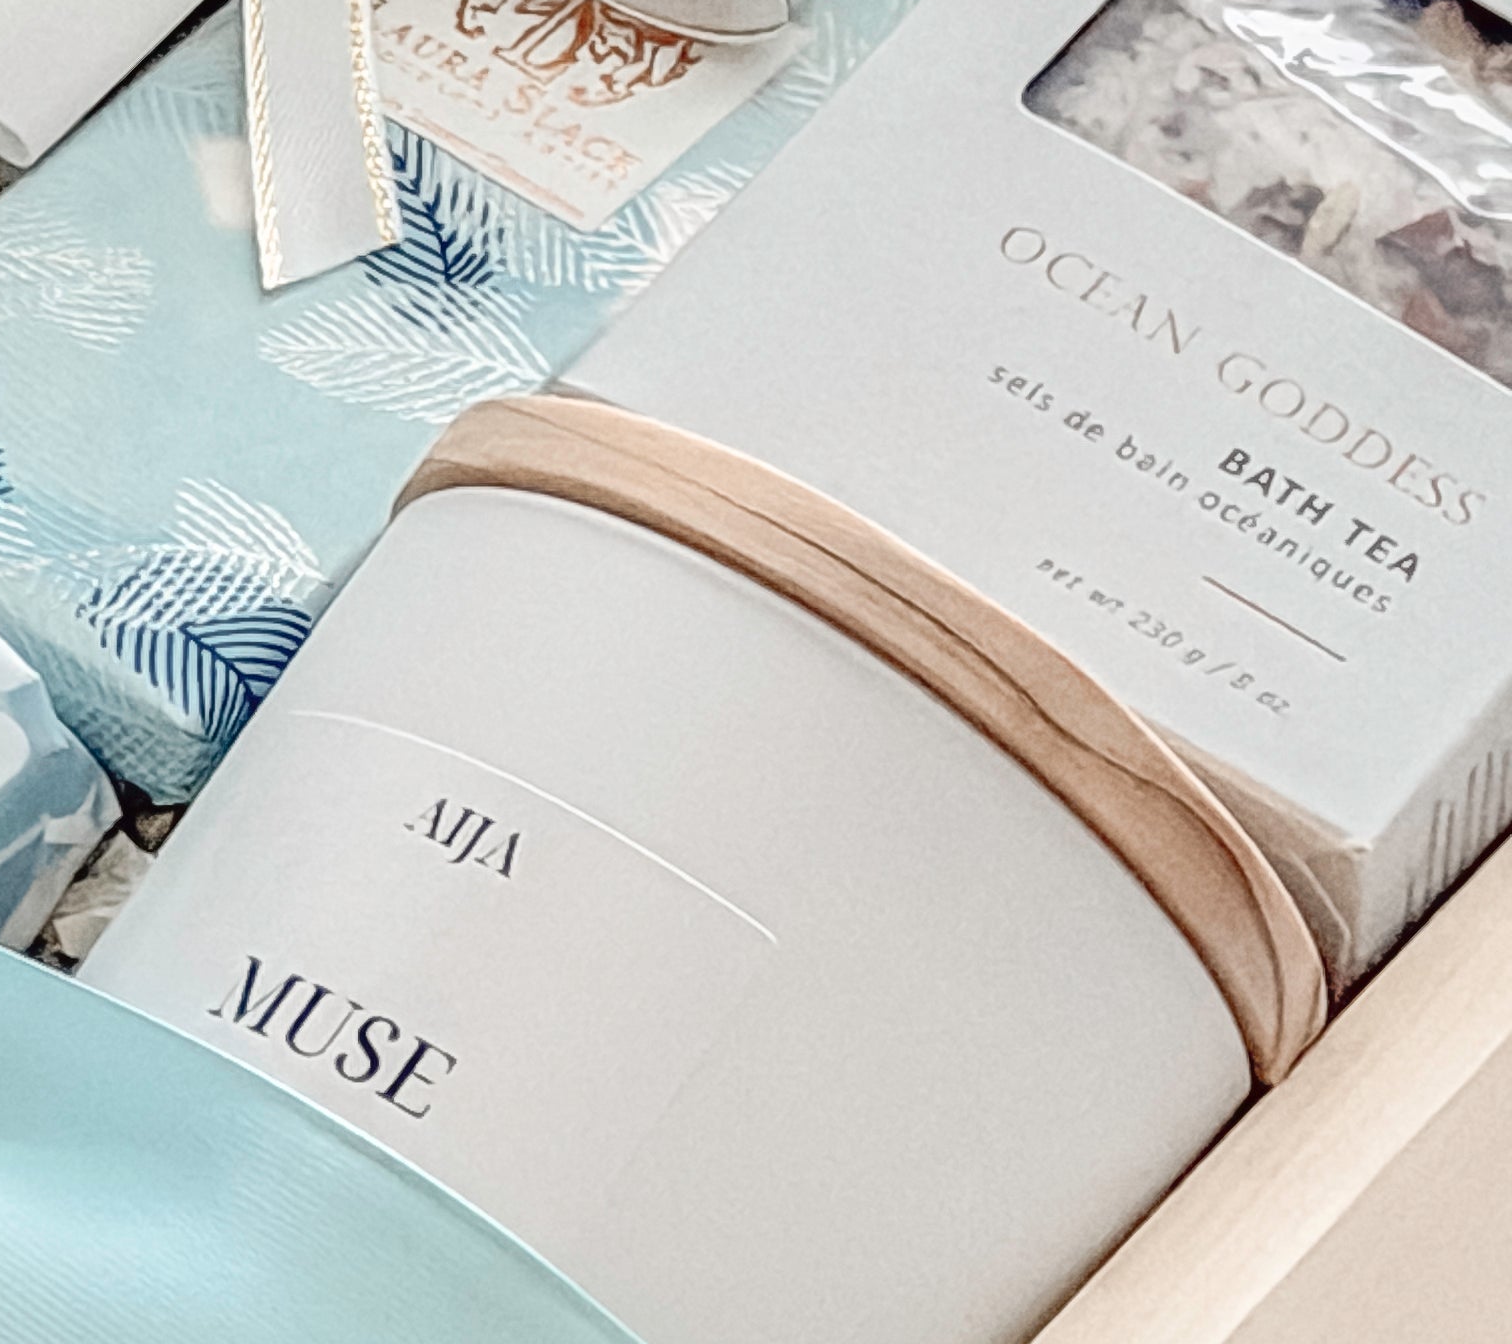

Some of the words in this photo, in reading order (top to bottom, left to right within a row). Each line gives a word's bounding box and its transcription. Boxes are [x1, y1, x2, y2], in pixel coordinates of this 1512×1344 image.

[999, 226, 1201, 354] OCEAN
[1216, 351, 1487, 527] GODDESS
[987, 364, 1055, 413] sels
[1062, 409, 1106, 443] de
[1114, 433, 1189, 493] bain
[1197, 489, 1394, 615] océaniques
[1218, 447, 1334, 526] BATH
[1343, 516, 1421, 583] TEA
[1127, 610, 1185, 649] 230
[402, 797, 522, 879] AIJA
[206, 954, 458, 1120] MUSE
